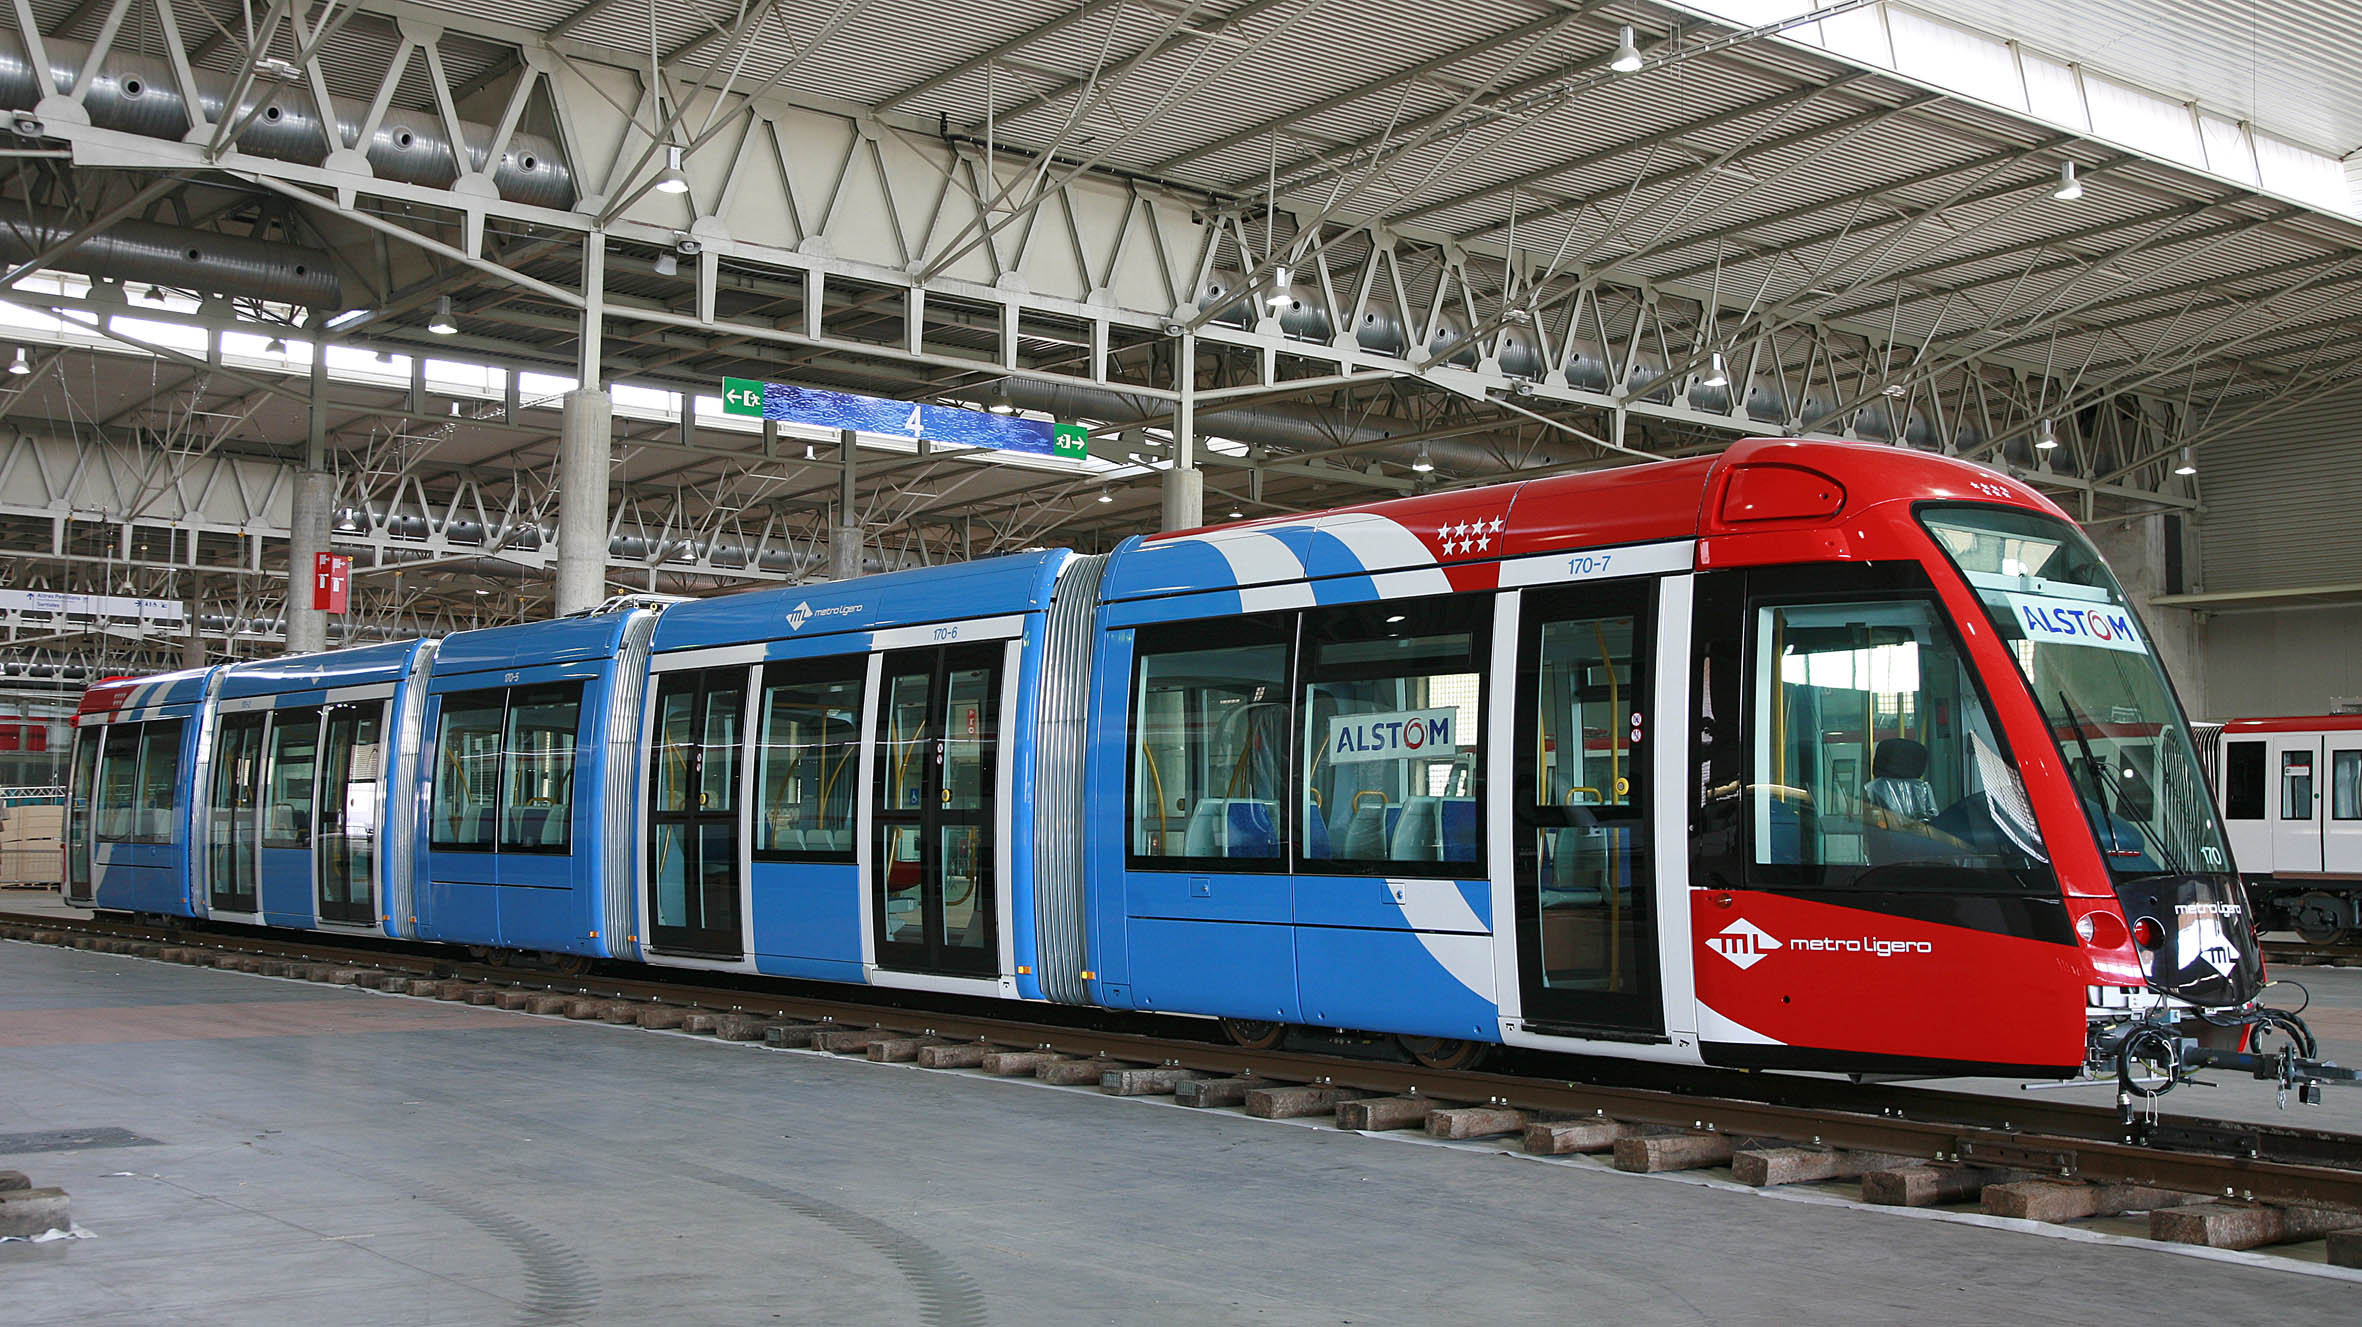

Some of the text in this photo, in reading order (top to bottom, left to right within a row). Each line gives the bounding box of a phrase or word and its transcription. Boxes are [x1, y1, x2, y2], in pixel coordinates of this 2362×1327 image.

[905, 405, 925, 438] 4
[1568, 555, 1612, 575] 170-7
[933, 626, 958, 641] 170-6
[2022, 605, 2135, 642] ALSTOM
[1336, 717, 1449, 753] ALSTOM
[2201, 846, 2222, 865] 170
[1790, 936, 1861, 952] metro
[1863, 936, 1933, 957] ligero
